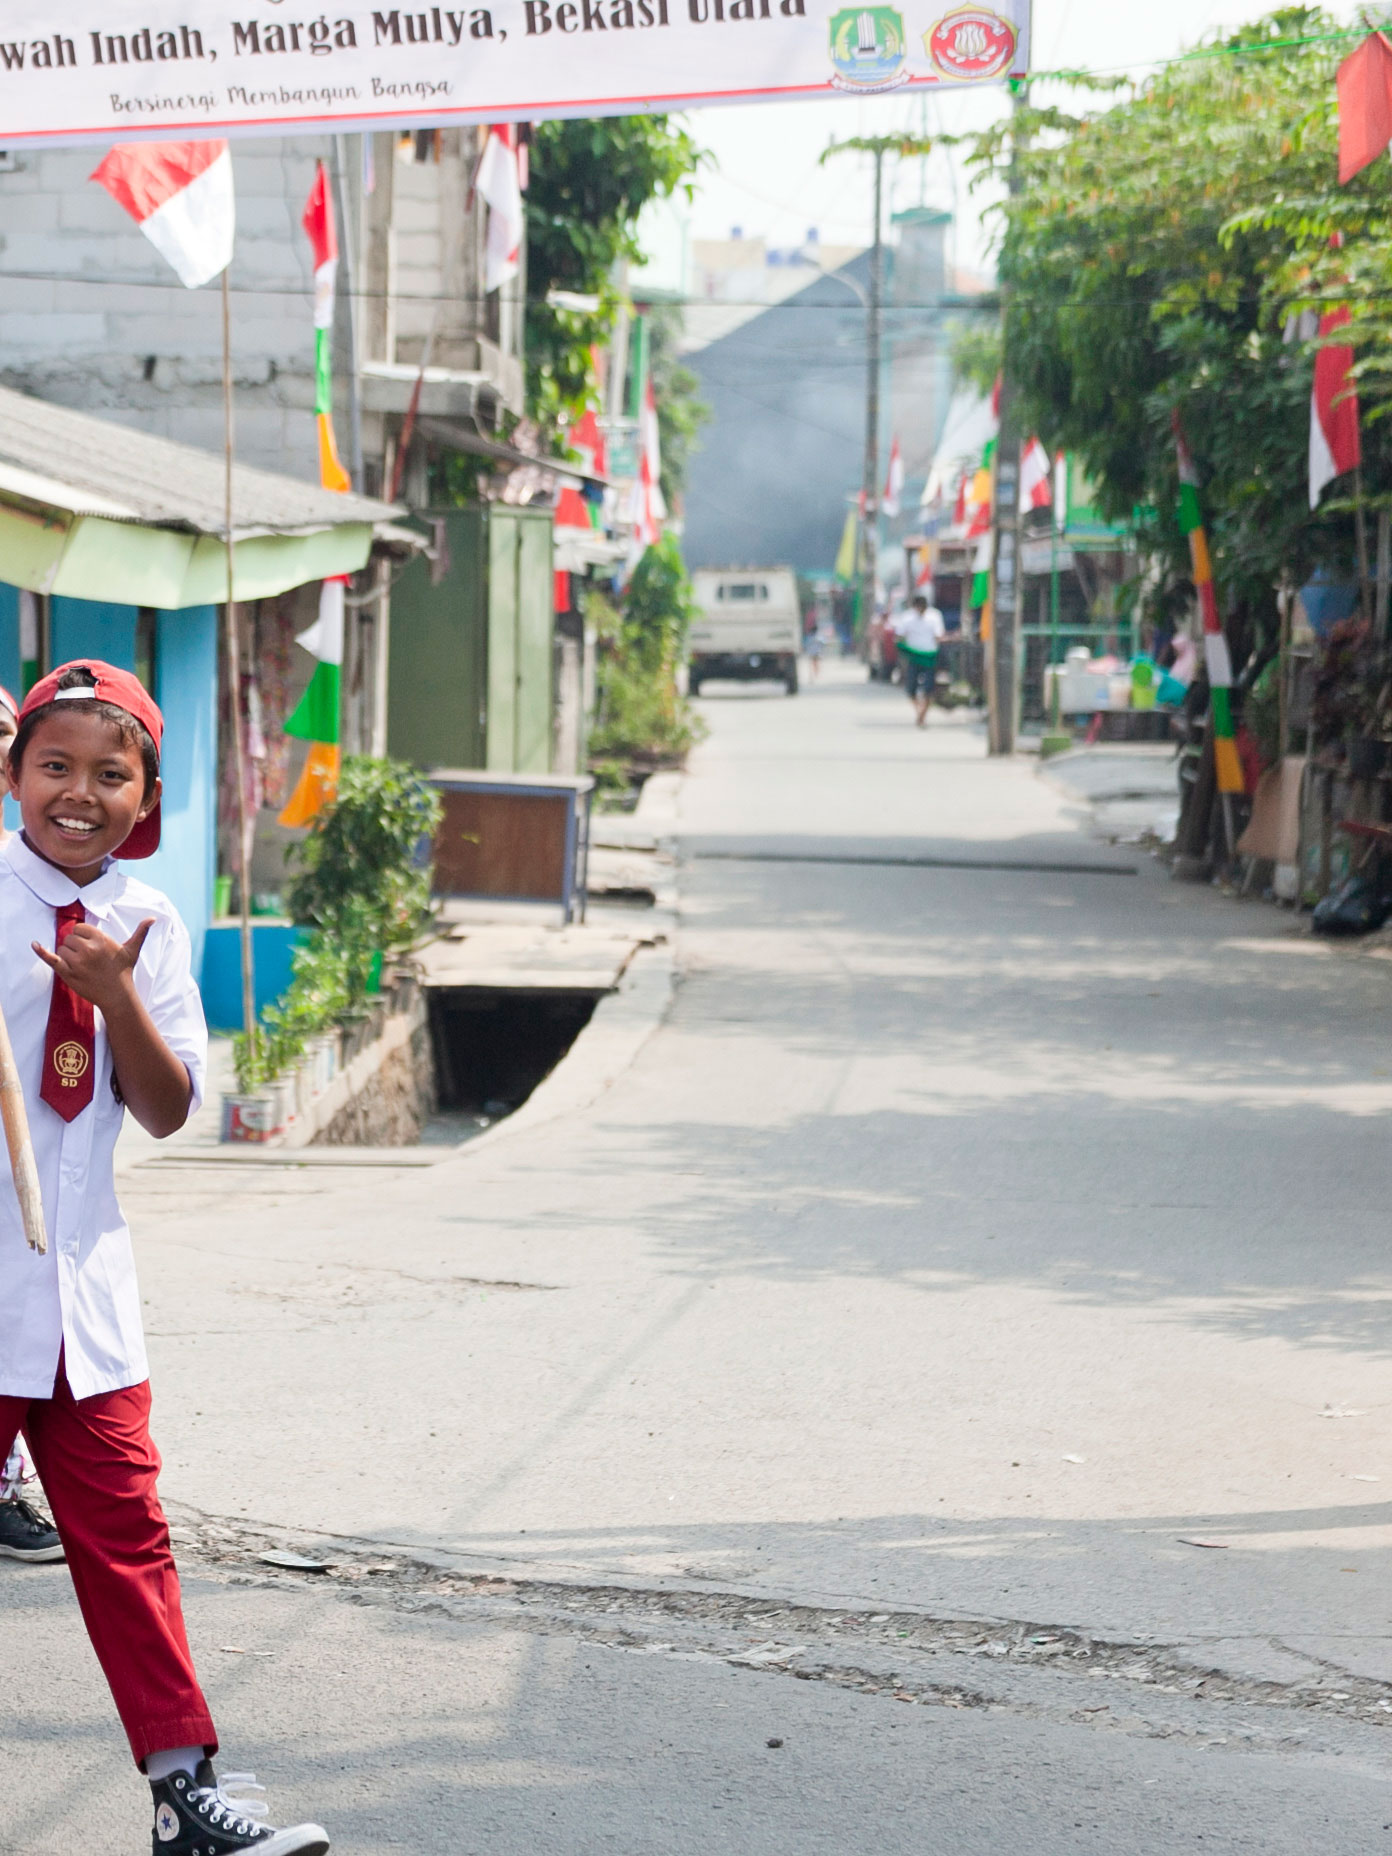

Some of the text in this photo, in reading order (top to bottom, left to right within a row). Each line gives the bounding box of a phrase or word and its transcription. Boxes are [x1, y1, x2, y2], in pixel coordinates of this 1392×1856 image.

[89, 25, 217, 65] Indah,
[231, 16, 357, 56] Marga
[371, 7, 507, 47] Mulya,
[524, 0, 669, 35] Bekasi
[110, 77, 452, 113] Bersinergi Membangun Bangsa
[61, 1078, 78, 1087] SD
